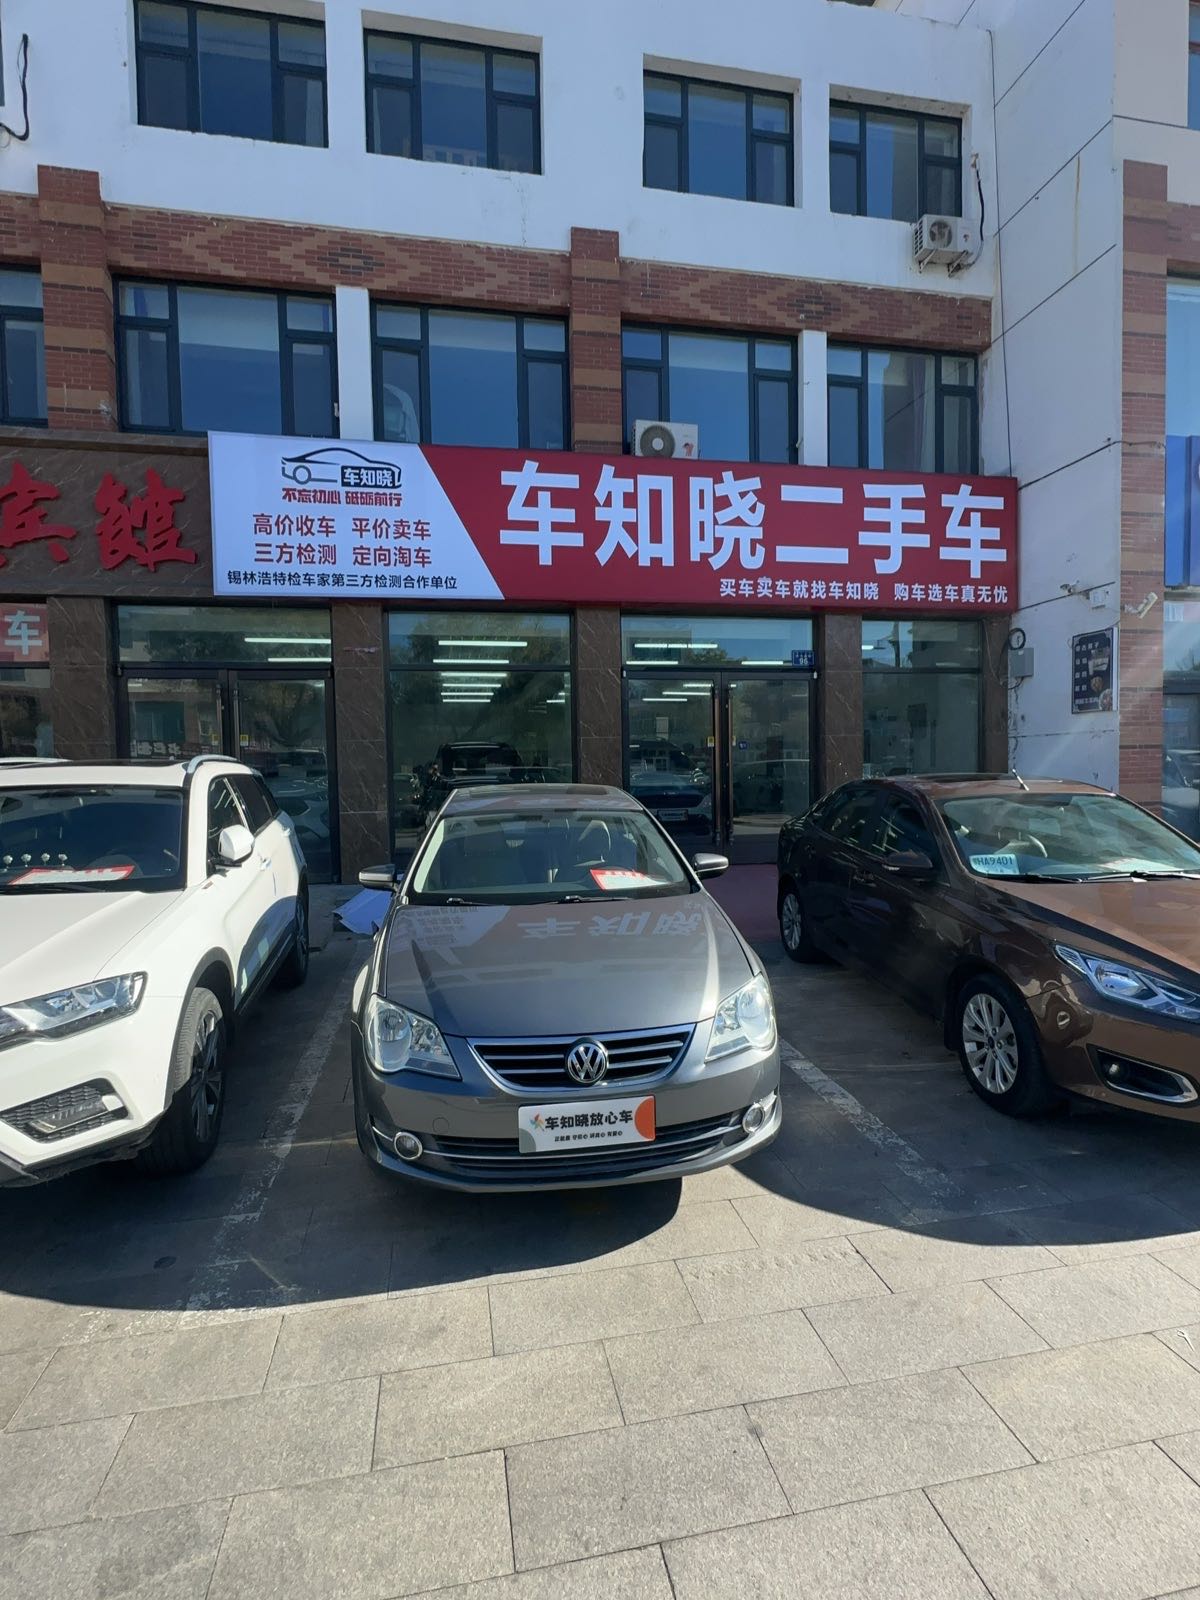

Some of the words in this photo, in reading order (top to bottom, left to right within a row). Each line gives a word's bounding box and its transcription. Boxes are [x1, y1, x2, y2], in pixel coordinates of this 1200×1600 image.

[343, 468, 393, 487] 车知晓
[282, 487, 342, 505] 不忘初心
[345, 490, 403, 507] 砥砺前行
[253, 513, 337, 537] 高价收车
[352, 517, 432, 541] 平价卖车
[500, 460, 1008, 580] 车知晓二手车
[254, 542, 337, 566] 三方检测
[352, 546, 432, 568] 定向淘车
[227, 570, 458, 589] 锡林浩特检车家第三方检测合作单位
[719, 576, 879, 600] 买车卖车就找车知晓
[894, 583, 1008, 604] 购车选车真无忧
[4, 610, 43, 656] 车
[545, 1110, 633, 1130] 车知晓放心车
